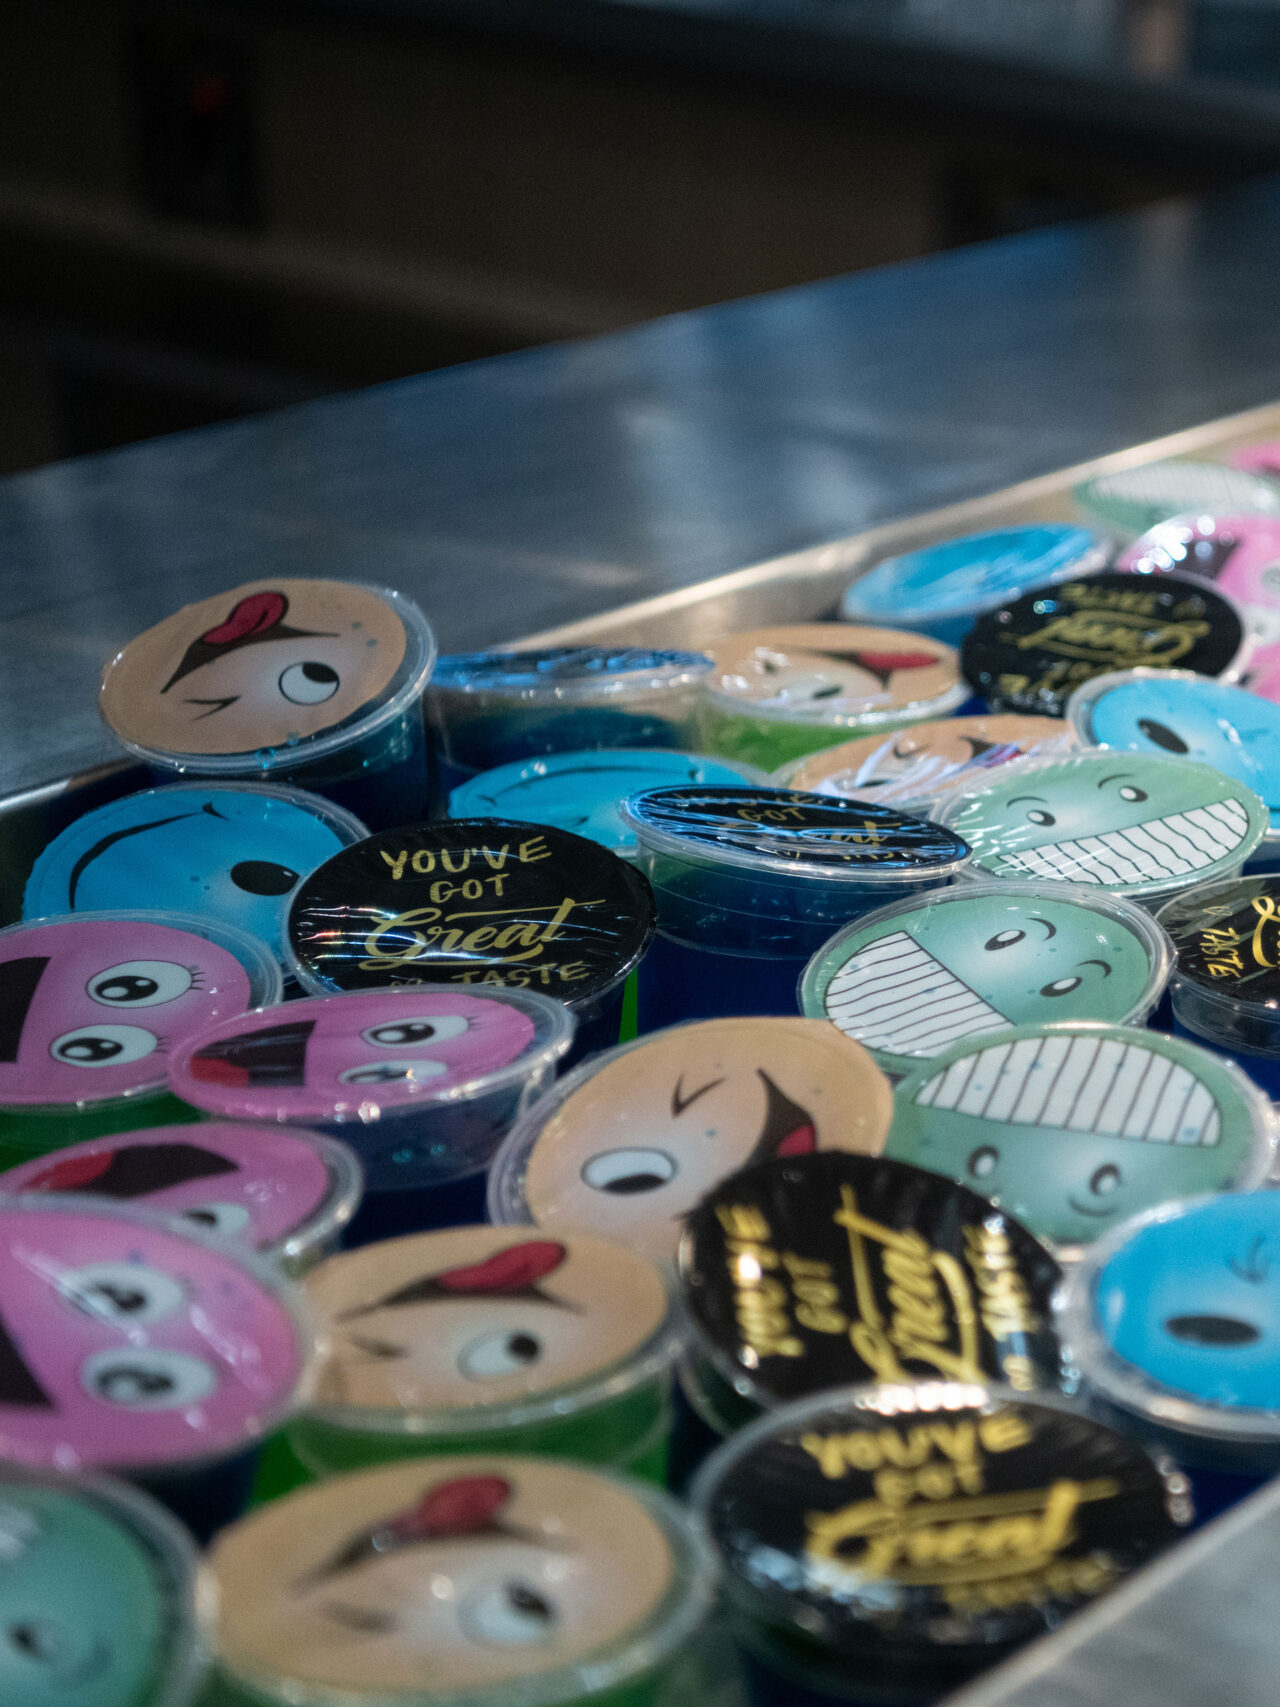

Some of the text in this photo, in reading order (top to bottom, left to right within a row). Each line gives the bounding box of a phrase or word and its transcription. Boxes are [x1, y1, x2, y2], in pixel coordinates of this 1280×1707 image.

[737, 807, 807, 822] GOT
[380, 836, 552, 880] YOU'VE
[429, 873, 511, 903] GOT
[358, 898, 606, 972] Great
[1201, 928, 1244, 979] TASTE
[451, 961, 592, 988] TASTE
